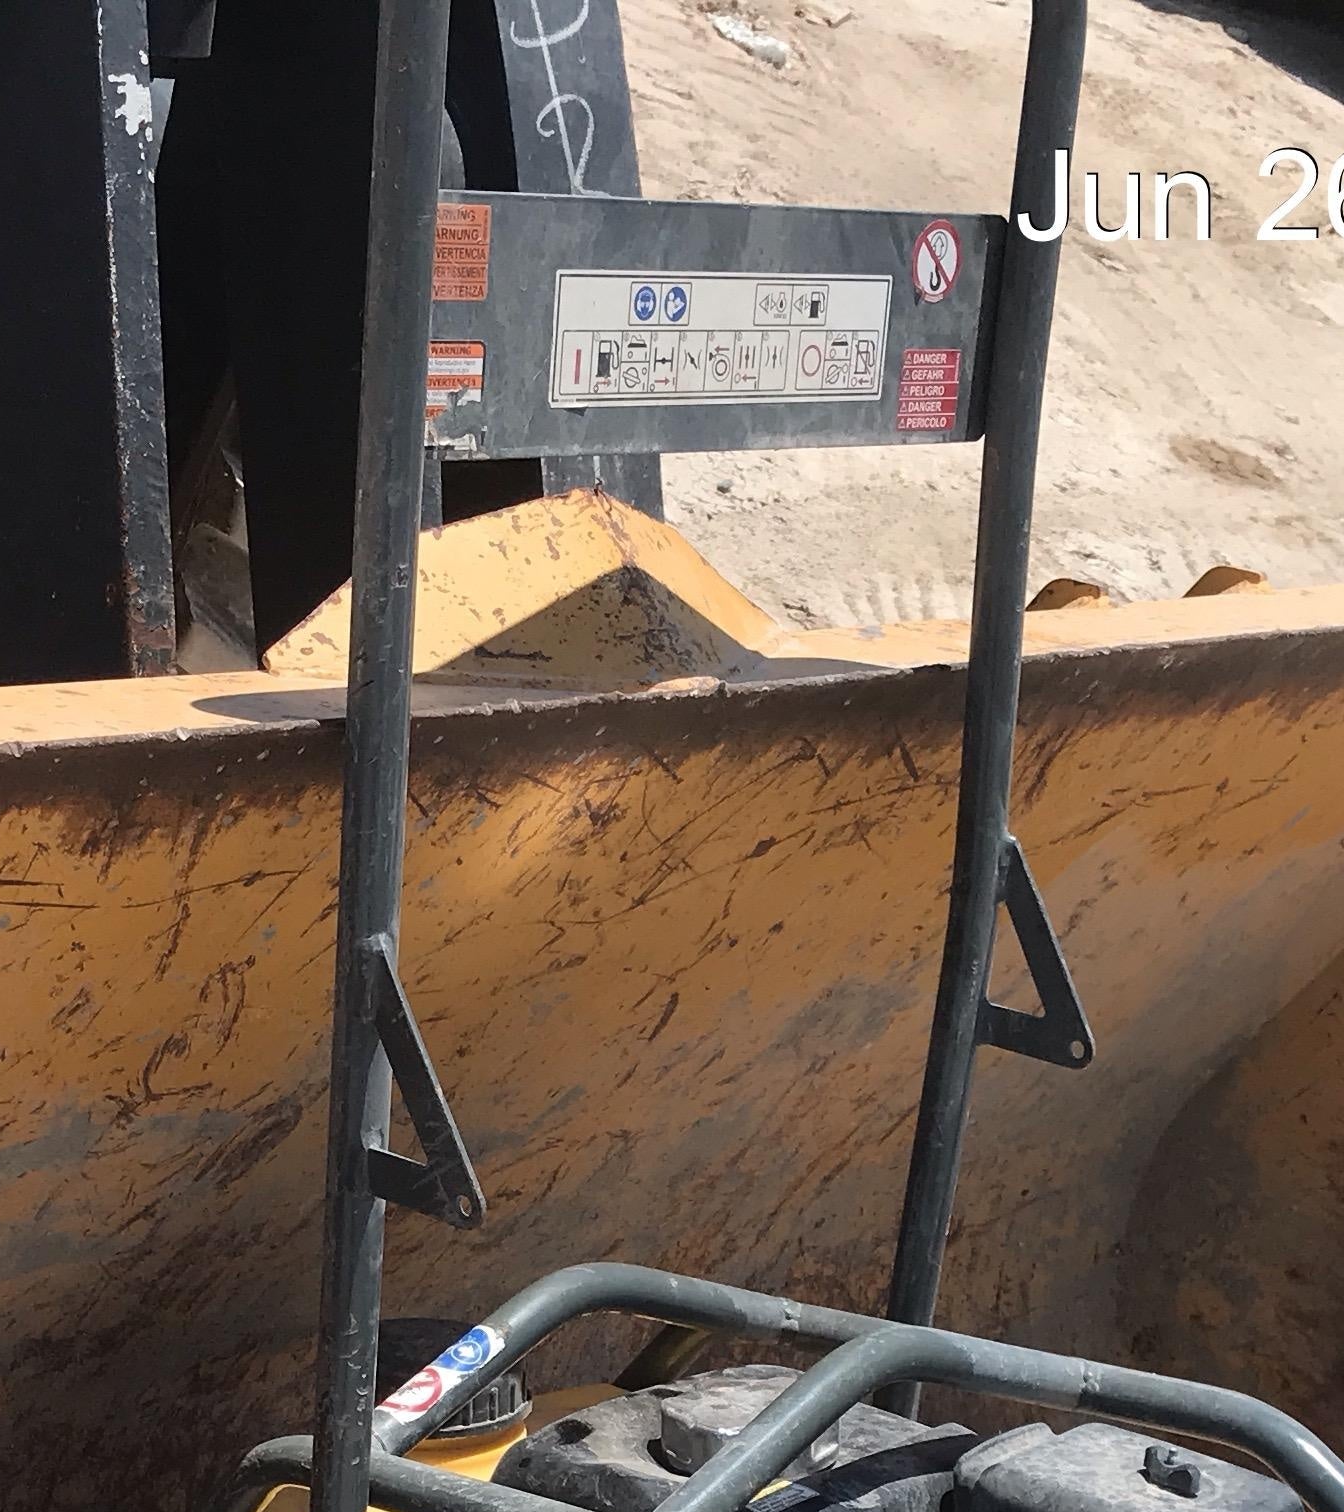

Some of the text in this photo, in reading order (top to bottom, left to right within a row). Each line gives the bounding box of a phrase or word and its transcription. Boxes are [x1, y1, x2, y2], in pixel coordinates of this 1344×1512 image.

[436, 227, 479, 240] ARNUNG
[436, 246, 486, 260] VERTENCIA
[433, 284, 484, 297] VERTENZA
[913, 353, 947, 364] DANGER
[911, 369, 944, 380] GEFAHR
[909, 385, 945, 397] PELIGRO
[908, 401, 942, 412] DANGER
[906, 416, 947, 428] PERICOLO
